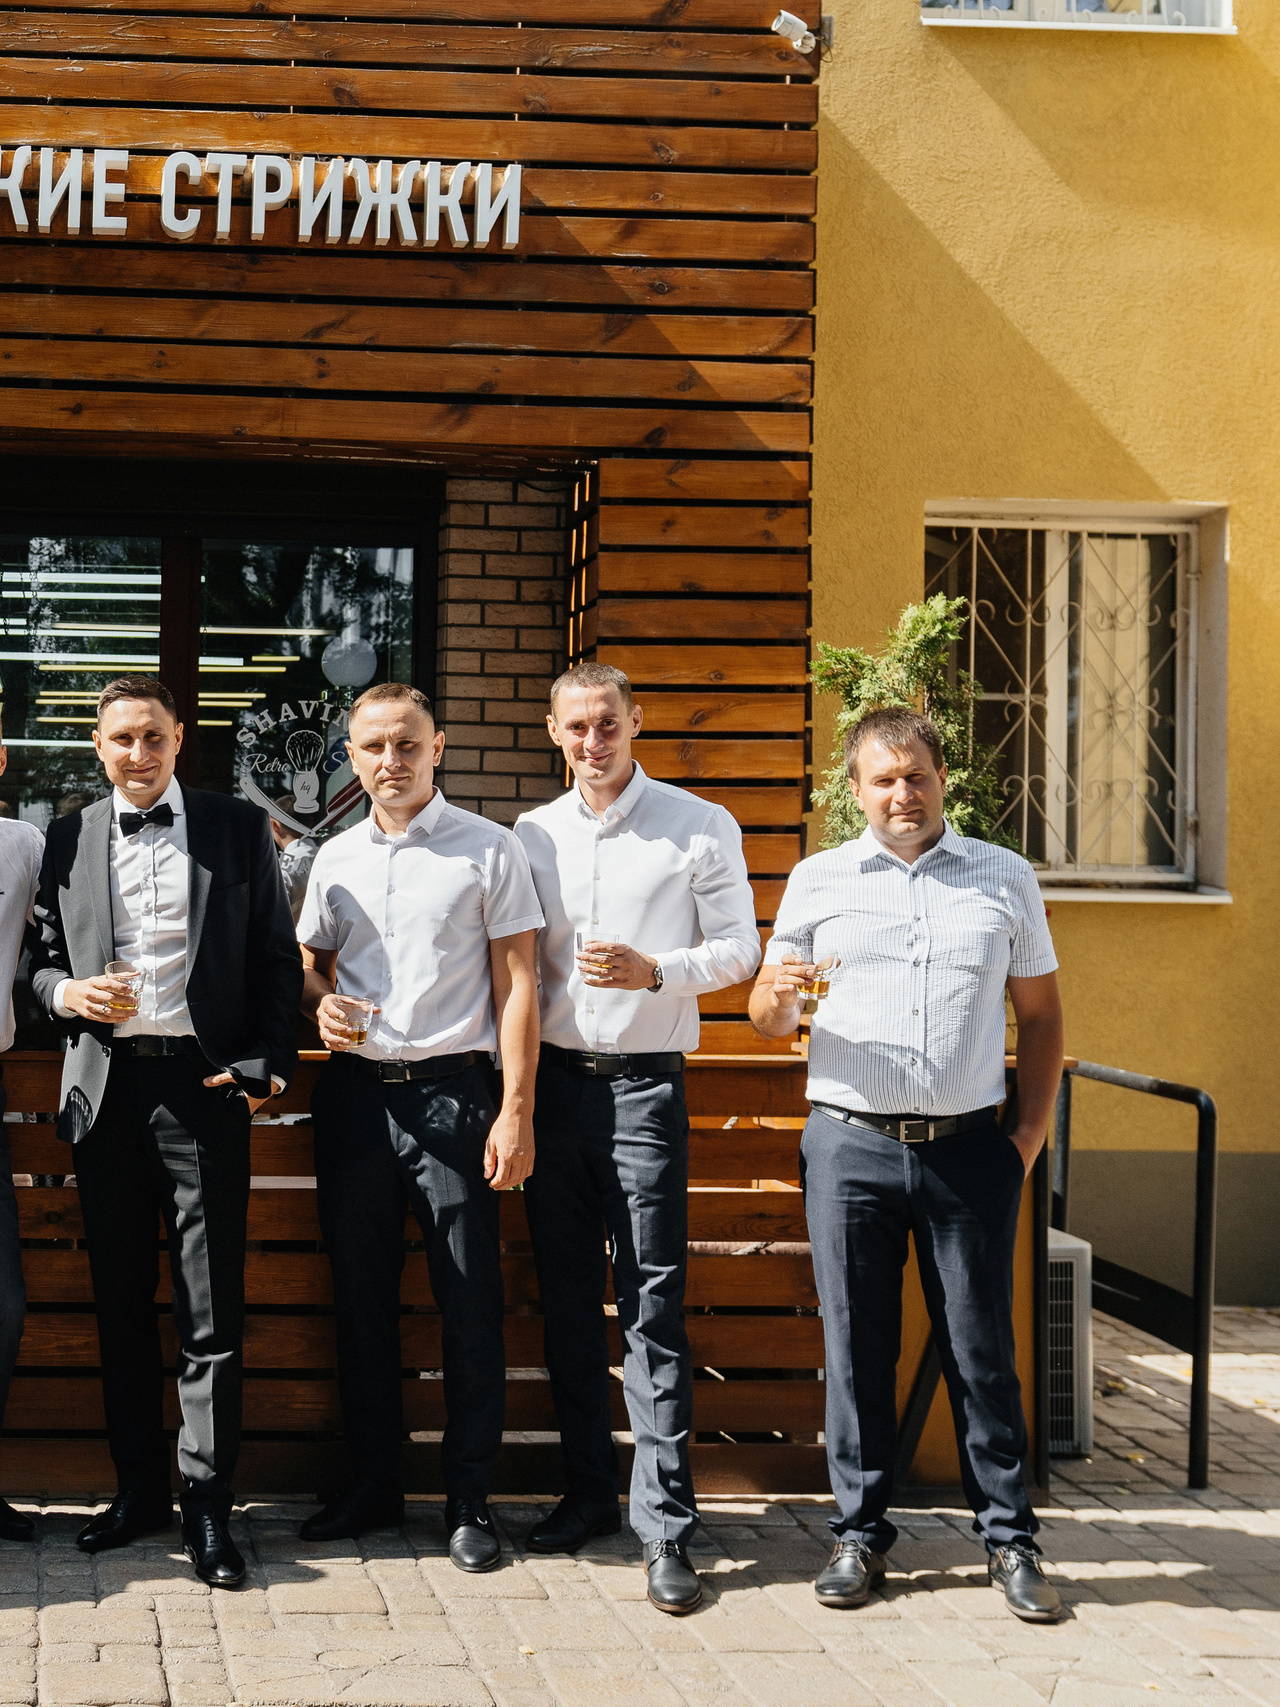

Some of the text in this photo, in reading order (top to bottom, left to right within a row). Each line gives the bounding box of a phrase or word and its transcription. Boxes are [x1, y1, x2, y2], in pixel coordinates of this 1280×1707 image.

[160, 151, 522, 250] СТРИЖКИ
[236, 700, 349, 749] SHAVIN
[243, 753, 290, 773] Retro
